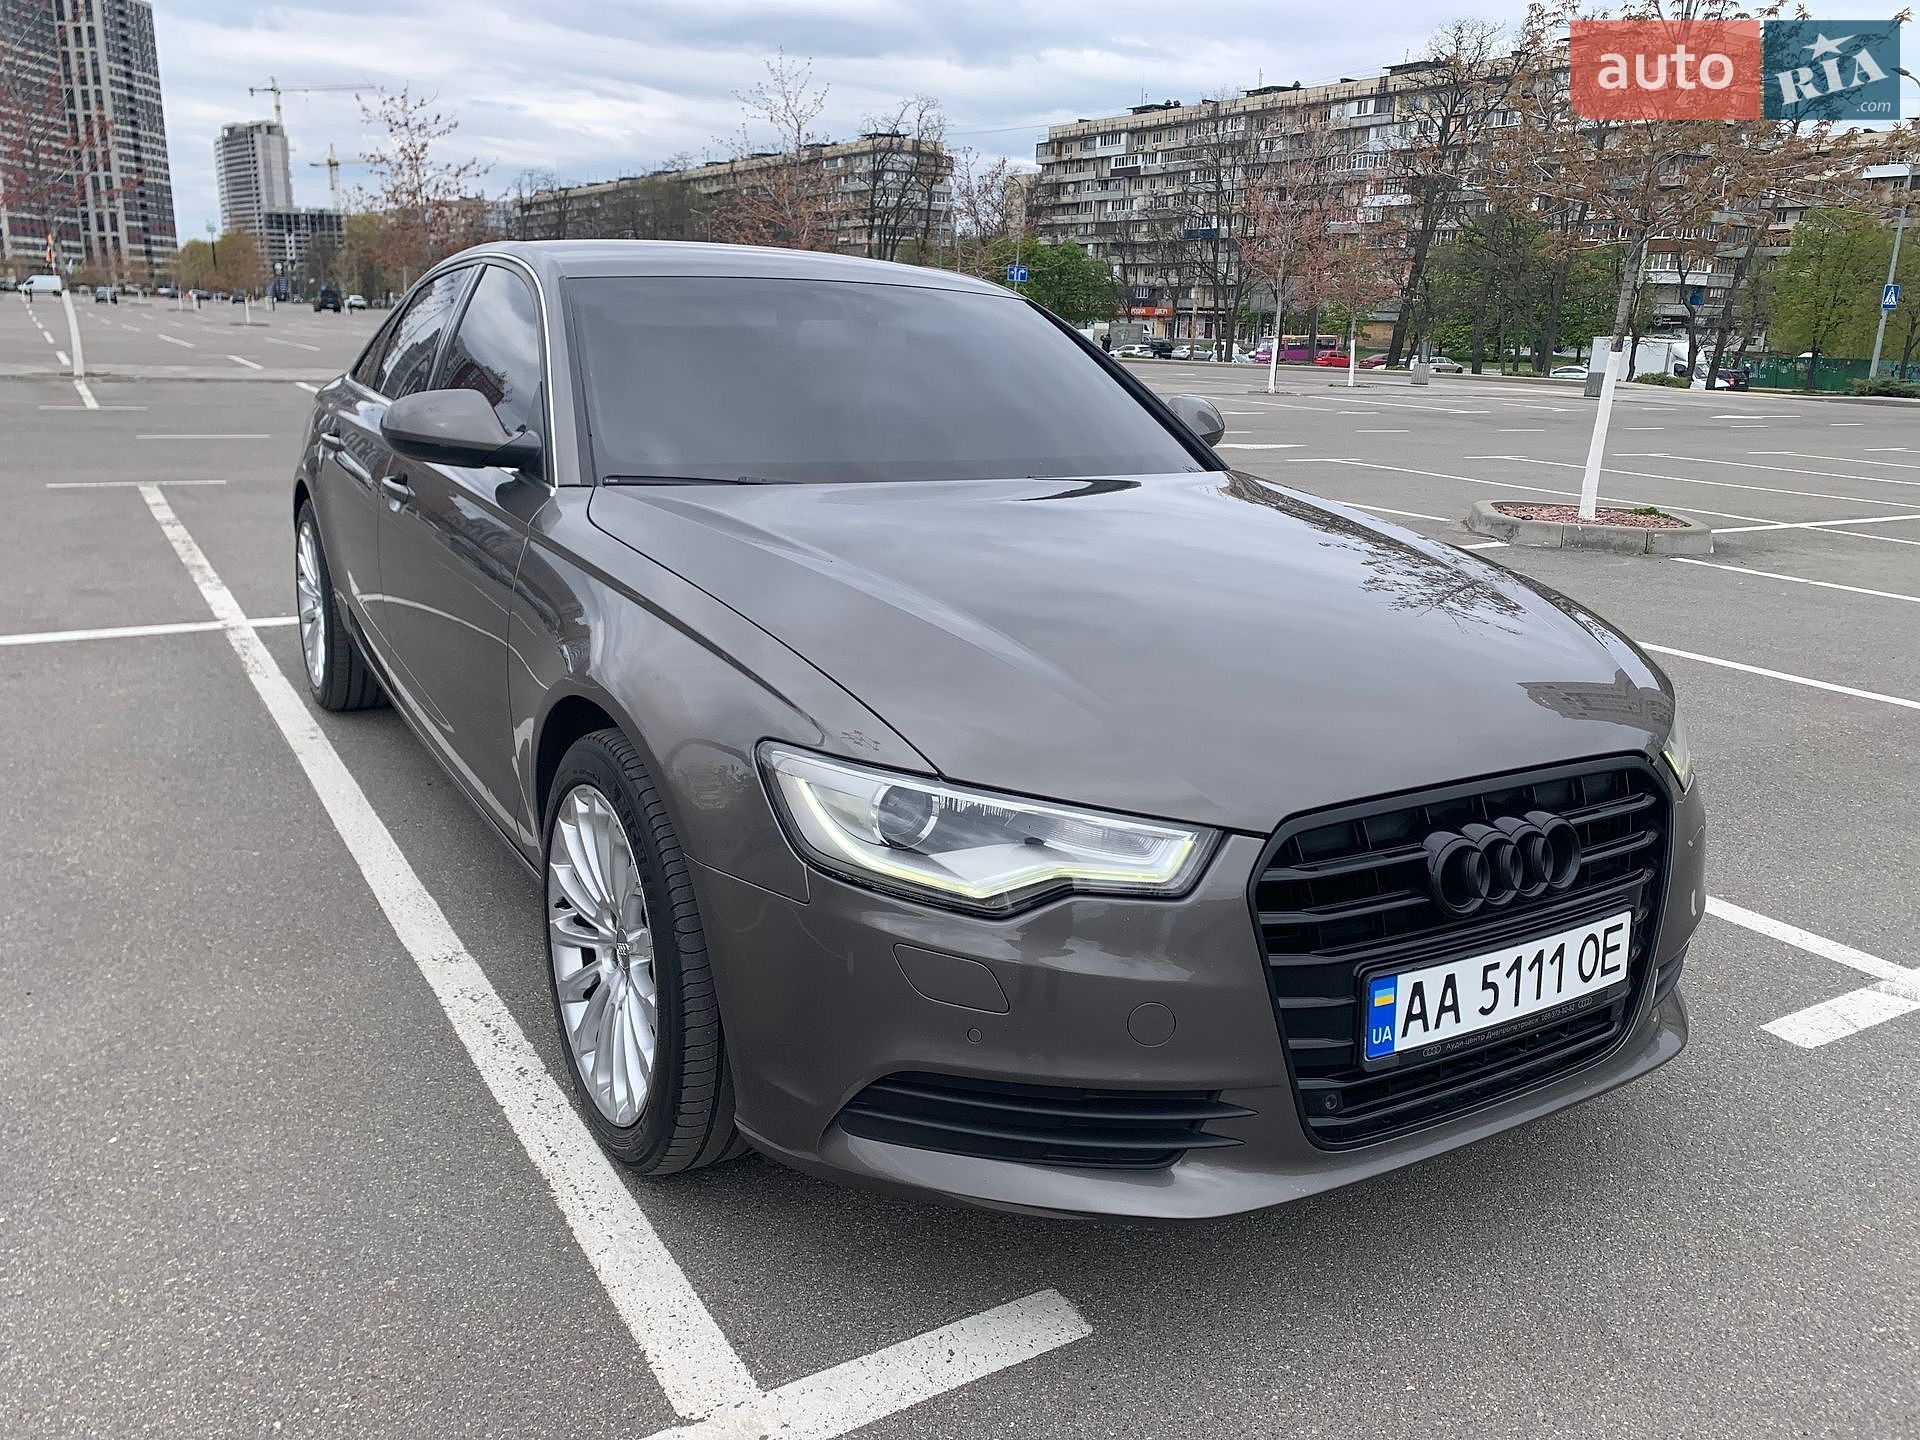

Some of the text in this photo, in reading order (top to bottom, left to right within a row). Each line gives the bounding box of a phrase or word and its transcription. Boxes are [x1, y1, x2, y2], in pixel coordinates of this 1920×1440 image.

[1401, 922, 1624, 1038] AA 5111 OE
[1372, 1026, 1393, 1045] UA
